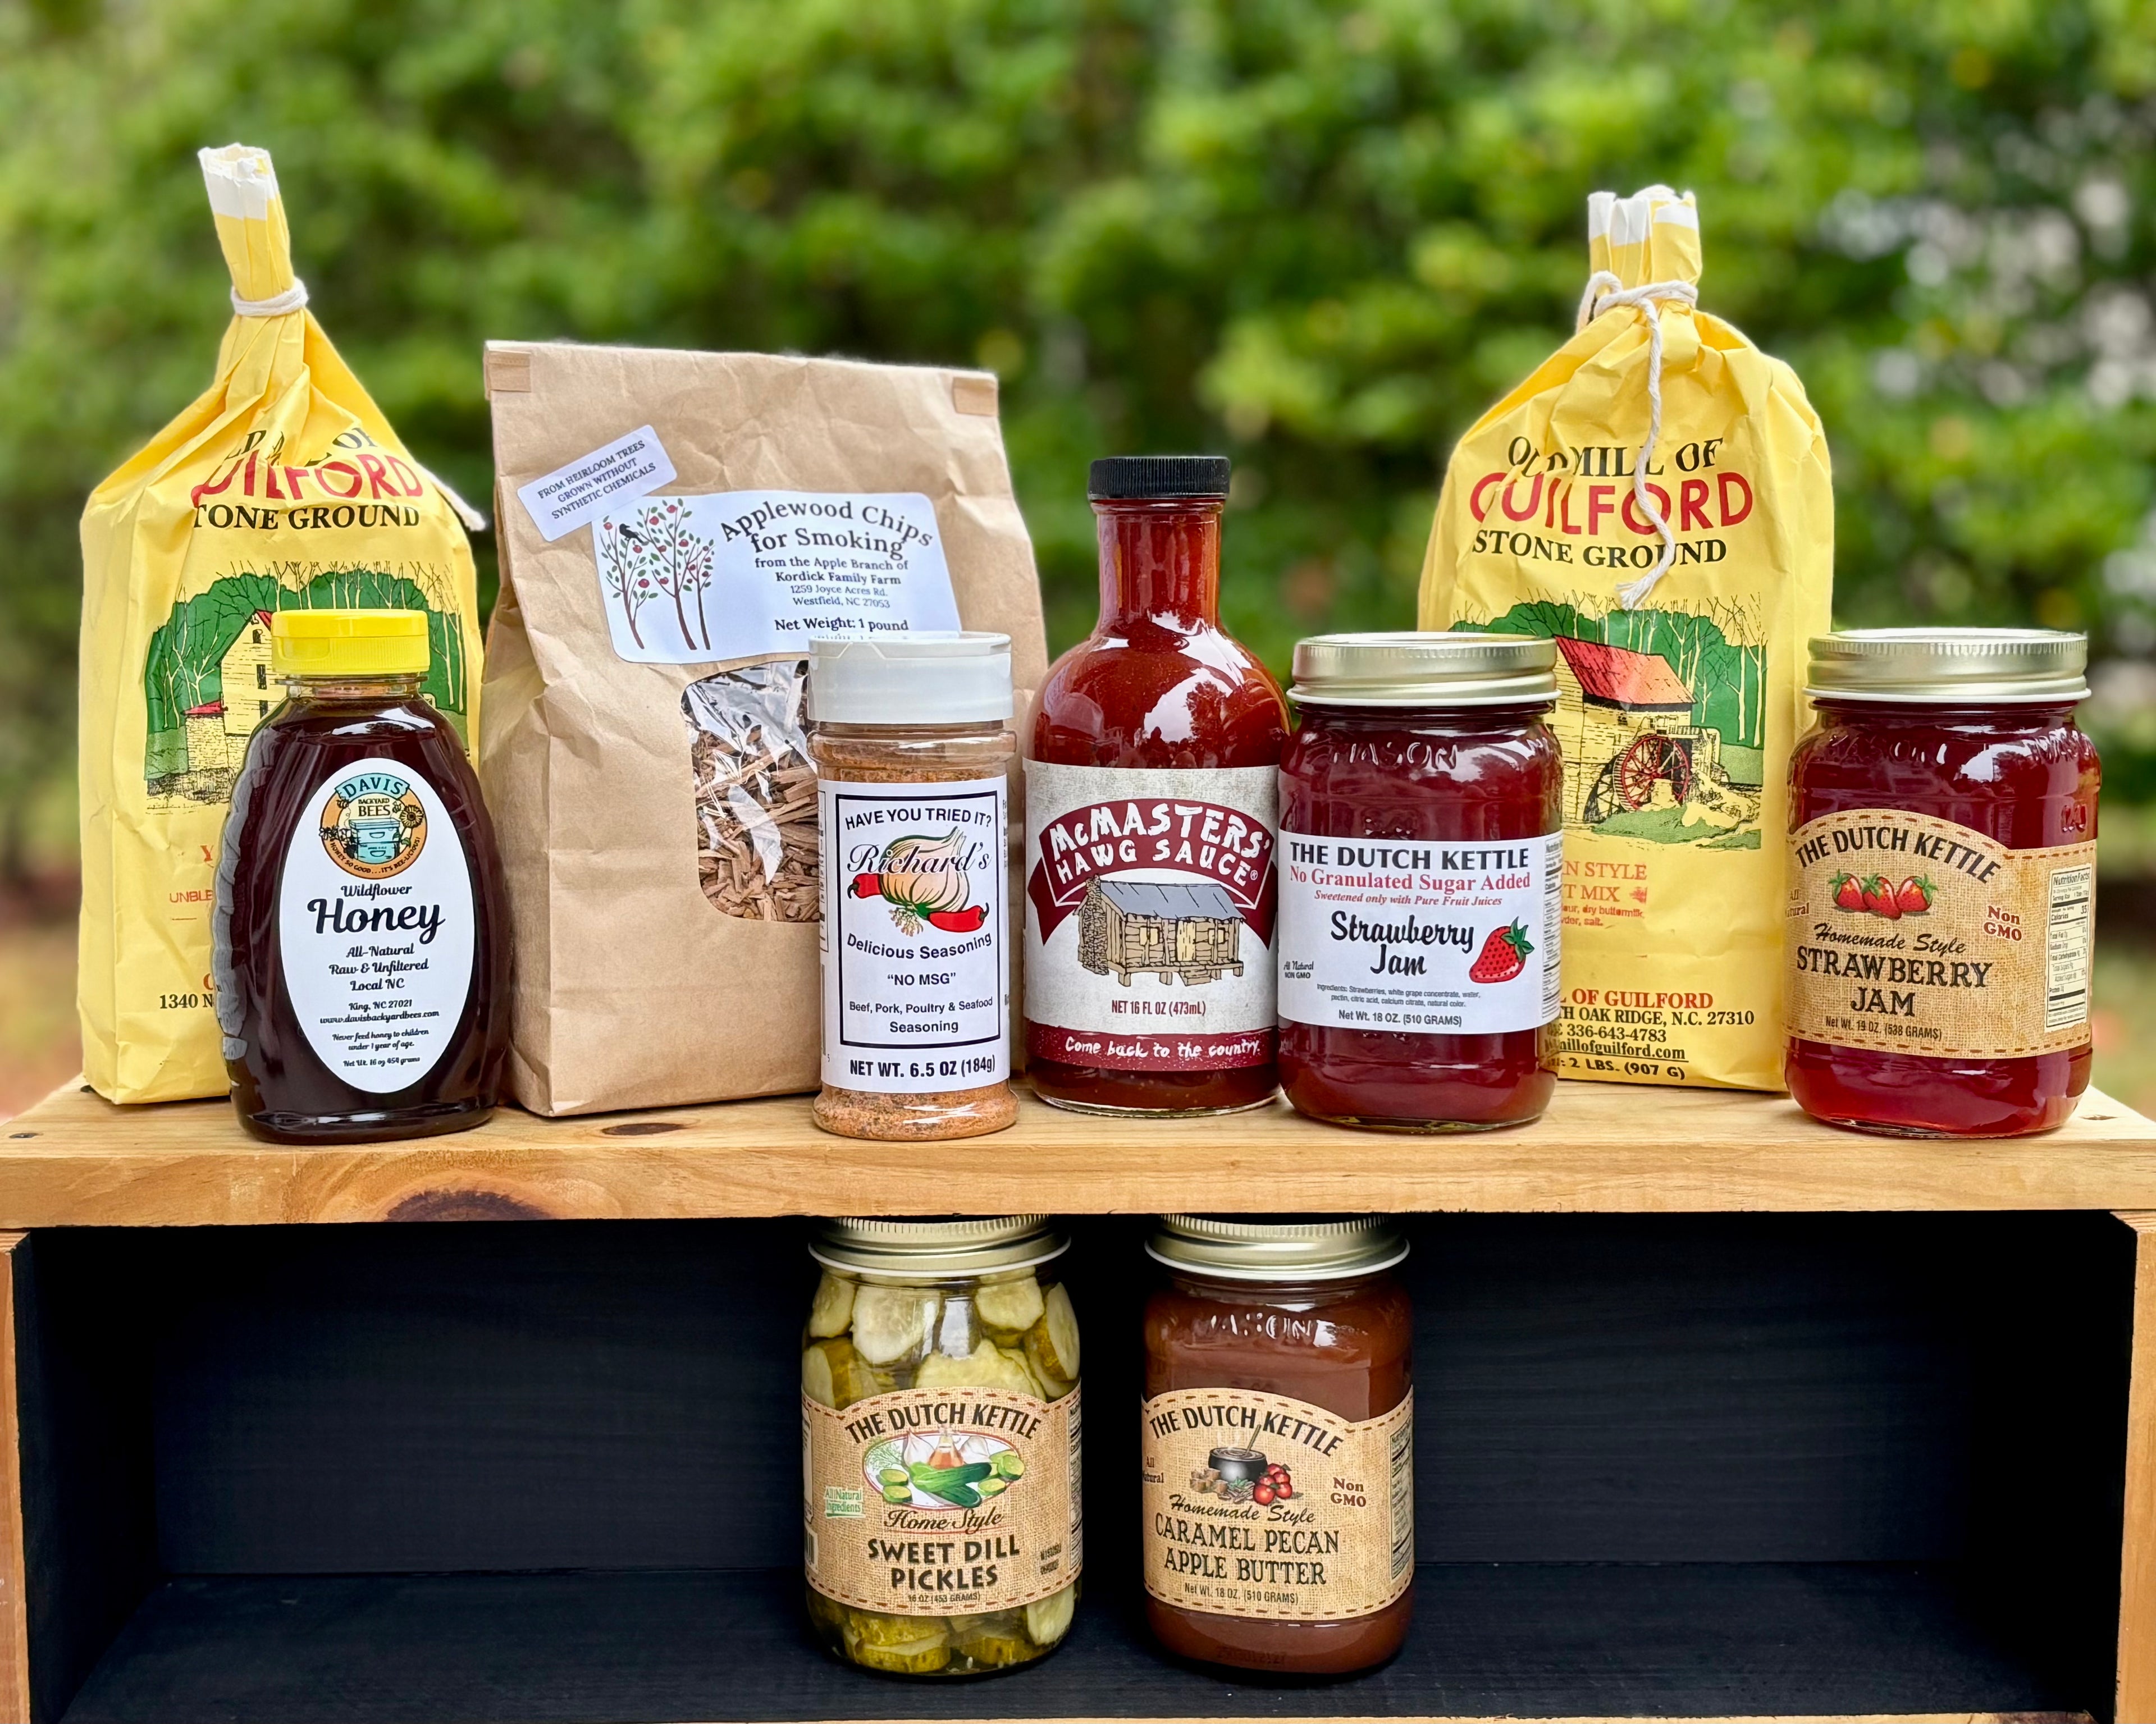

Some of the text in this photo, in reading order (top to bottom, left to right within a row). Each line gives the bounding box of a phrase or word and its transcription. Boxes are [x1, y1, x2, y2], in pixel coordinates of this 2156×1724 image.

[1508, 436, 1568, 478] OLD
[1675, 437, 1723, 472] OF
[191, 449, 423, 507] UILFORD
[537, 440, 646, 499] FROM HEIRLOOM TREES
[558, 457, 637, 503] GROWN WITHOUT
[551, 463, 656, 519] SYNTHETIC CHEMICALS
[1470, 472, 1753, 535] GUILFORD
[194, 504, 419, 529] TONE GROUND
[720, 501, 934, 547] Applewood Chips
[751, 527, 907, 561] for Smoking
[1472, 529, 1726, 569] STONE GROUND
[755, 556, 908, 570] from the Apple Branch of
[775, 571, 902, 585] Kordick Family Farm
[790, 585, 888, 597] 1259 Joyce Acres Rd.
[792, 596, 890, 609] Westfield, NC 27053
[774, 617, 909, 632] Net Weight: pound
[342, 778, 403, 798] DAVIS
[358, 805, 390, 817] BEES
[846, 808, 992, 830] HAVE YOU TRIED IT?
[847, 842, 993, 875] Richard's
[1056, 839, 1138, 884] HAWG
[1290, 842, 1529, 870] THE DUTCH KETTLE
[1795, 826, 2001, 884] THE DUTCH KETTLE
[1290, 865, 1531, 895] No Granulated Sugar Added
[1585, 862, 1647, 880] STYLE
[341, 883, 412, 900] Wildflower
[1314, 889, 1502, 907] Sweetened only with Pure Fruit Juices
[1581, 885, 1620, 902] MIX
[307, 898, 446, 944] Honey
[1988, 906, 2021, 925] Non
[1331, 911, 1474, 954] Strawberry
[1814, 922, 1966, 957] Homemade Style
[1983, 921, 2022, 941] GMO
[346, 943, 414, 958] All-Natural
[847, 933, 992, 959] Delicious Seasoning
[328, 958, 429, 976] Raw & Unfiltered
[1370, 944, 1427, 976] Jam
[1797, 945, 1993, 988] STRAWBERRY
[350, 978, 405, 991] Local NC
[887, 973, 956, 986] “NO MSG”
[160, 994, 198, 1008] 1340
[349, 1003, 371, 1012] King,
[388, 999, 412, 1008] 27021
[849, 1002, 873, 1014] Beef,
[875, 1003, 903, 1014] Pork,
[906, 1003, 945, 1014] Poultry
[948, 1003, 956, 1012] &
[958, 996, 993, 1010] Seafood
[1111, 1000, 1206, 1017] NET 16 FL OZ (473mL)
[1572, 988, 1714, 1009] OF GUILFORD
[1851, 986, 1916, 1017] JAM
[320, 1010, 440, 1023] www.davisbackyardbees.com
[889, 1021, 959, 1033] Seasoning
[1339, 1010, 1461, 1027] Net Wt. 18 OZ. (510 GRAMS)
[1579, 1007, 1611, 1022] OAK
[1614, 1009, 1667, 1028] RIDGE,
[1671, 1012, 1702, 1026] N.C.
[1707, 1010, 1755, 1025] 27310
[354, 1032, 369, 1042] feed
[1566, 1023, 1667, 1042] 336-643-4783
[1065, 1036, 1260, 1058] Come back to the country.
[850, 1054, 995, 1077] NET WT. 6.5 OZ (184g)
[845, 1402, 1042, 1444] THE DUTCH KETTLE
[1149, 1405, 1344, 1457] THE DUTCH KETTLE
[1333, 1476, 1364, 1493] Non
[1169, 1494, 1315, 1526] Homemade Style
[1330, 1493, 1367, 1508] GMO
[884, 1506, 1005, 1535] Home Style
[1155, 1512, 1340, 1554] CARAMEL PECAN
[868, 1538, 954, 1564] SWEET
[964, 1534, 1020, 1562] DILL
[1164, 1547, 1326, 1585] APPLE BUTTER
[891, 1564, 998, 1591] PICKLES
